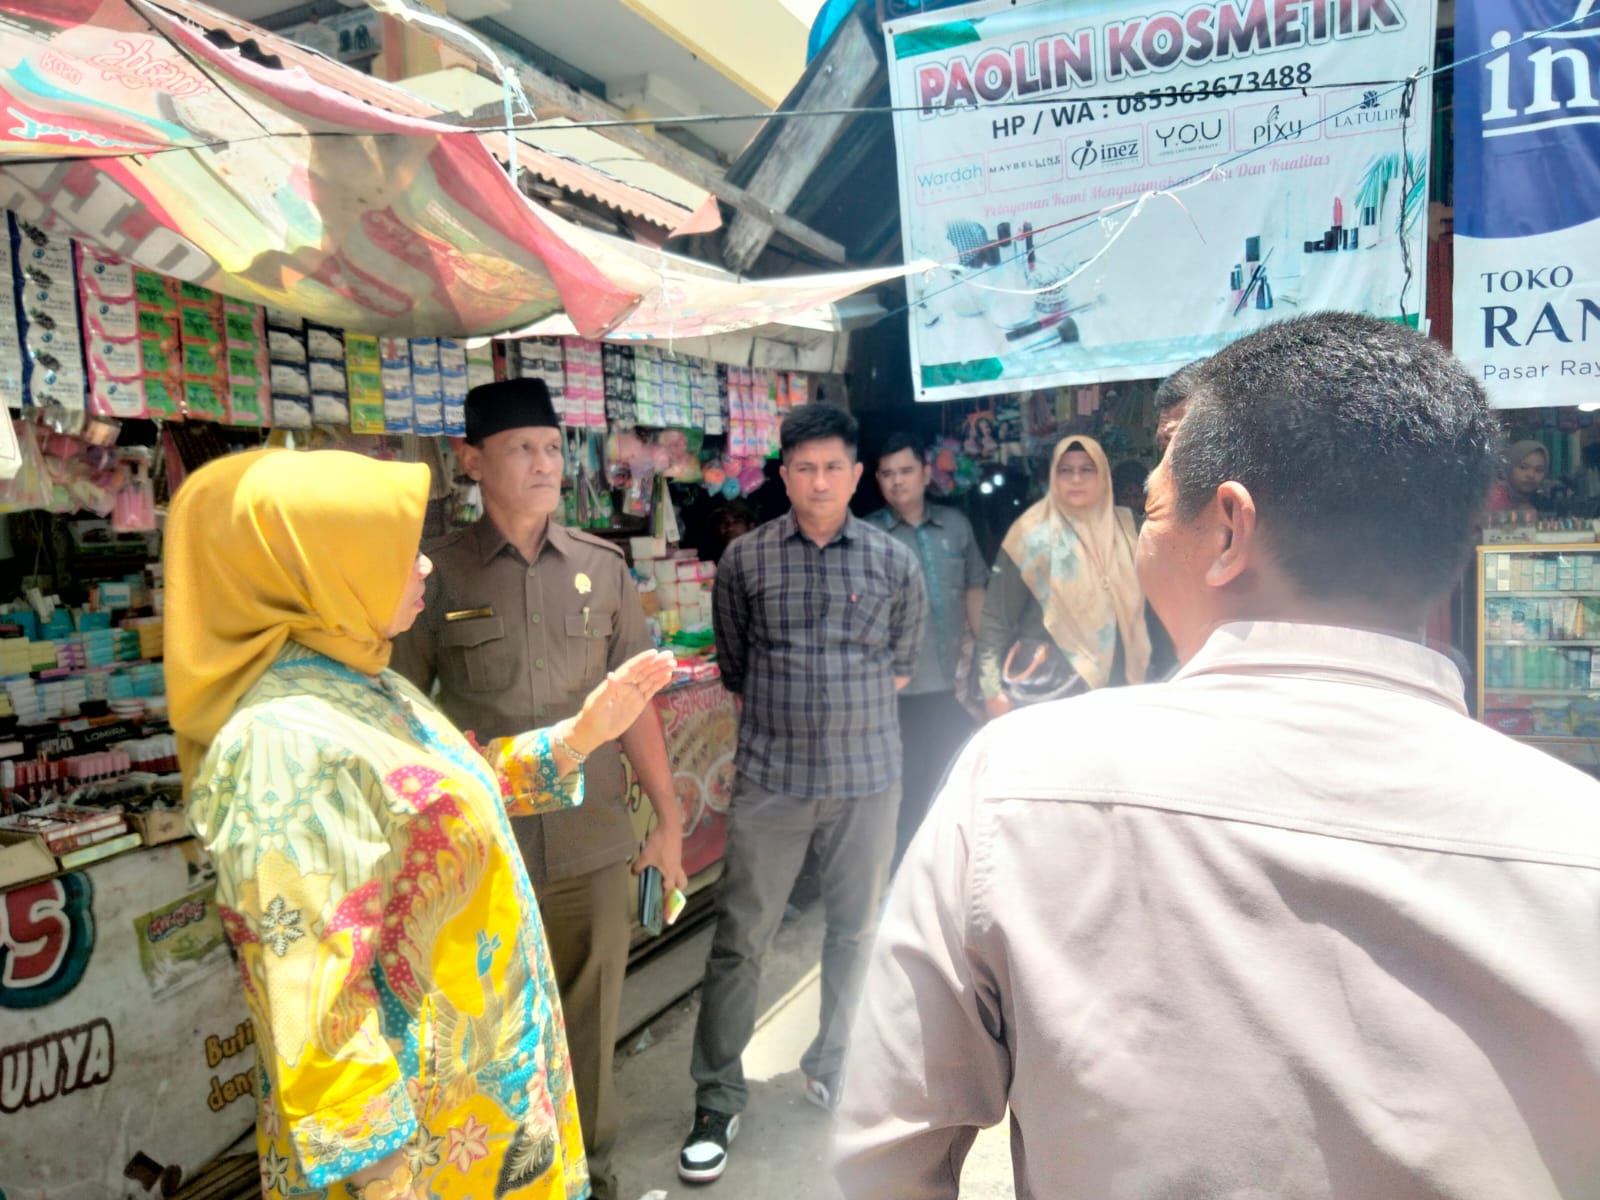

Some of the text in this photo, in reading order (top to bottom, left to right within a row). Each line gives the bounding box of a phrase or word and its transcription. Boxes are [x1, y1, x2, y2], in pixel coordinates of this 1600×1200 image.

[918, 0, 1401, 116] PAOLIN KOSMETIK
[993, 115, 1026, 139] HP
[1051, 102, 1094, 127] WA
[1116, 62, 1312, 116] 085363673488
[1101, 141, 1139, 160] inez
[917, 164, 983, 189] Wardah
[1237, 162, 1265, 177] Dan
[1270, 154, 1331, 173] Kualitas
[1480, 265, 1573, 293] TOKO
[1484, 364, 1549, 380] Pasar
